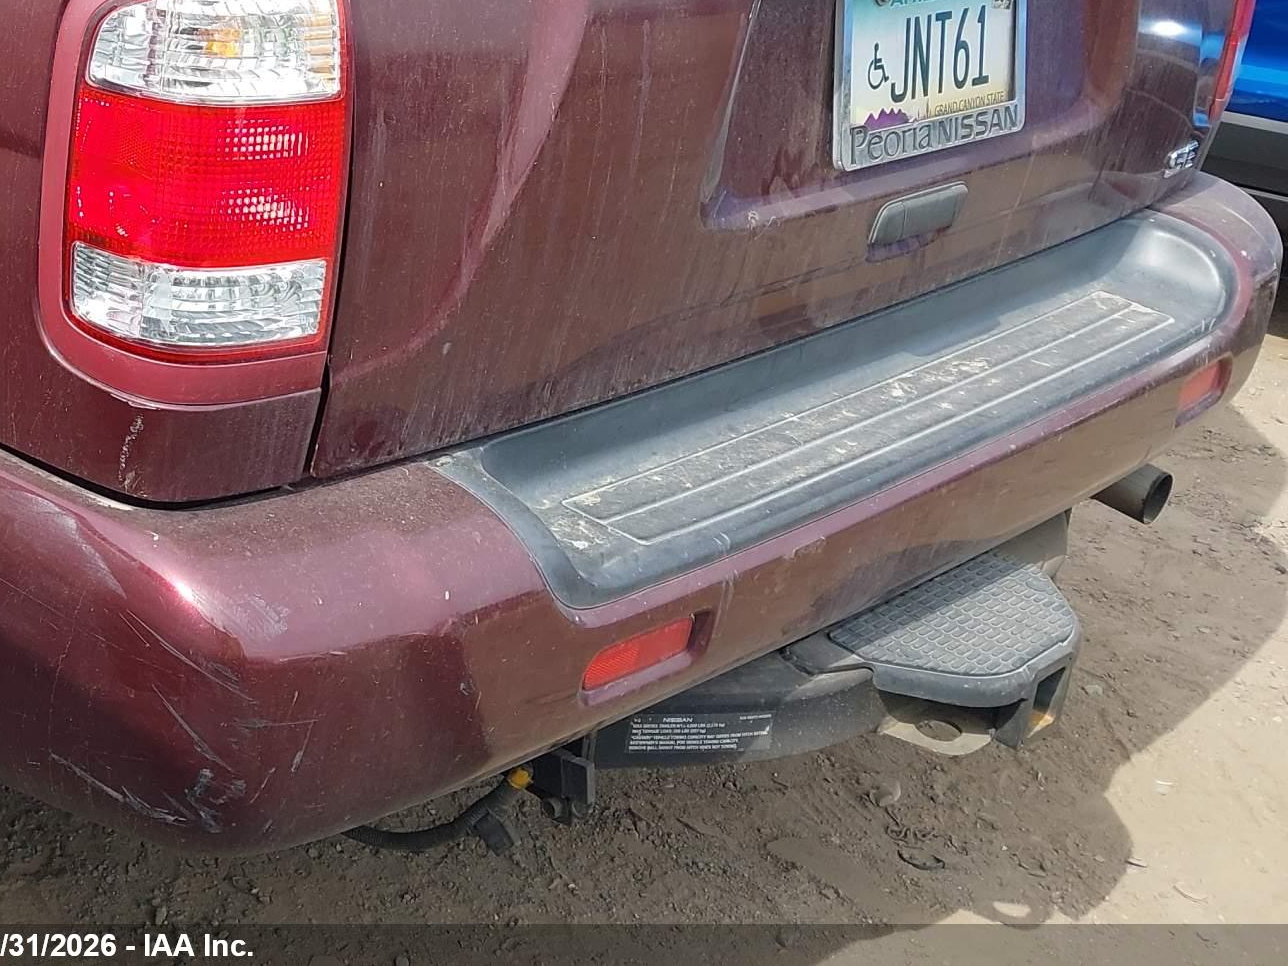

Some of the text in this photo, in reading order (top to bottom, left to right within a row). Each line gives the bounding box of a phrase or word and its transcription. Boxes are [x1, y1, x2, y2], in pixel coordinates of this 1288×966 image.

[890, 4, 990, 104] JNT61
[849, 103, 1019, 165] Peoria NISSAN
[934, 91, 1005, 117] GRAND CANYON STATE
